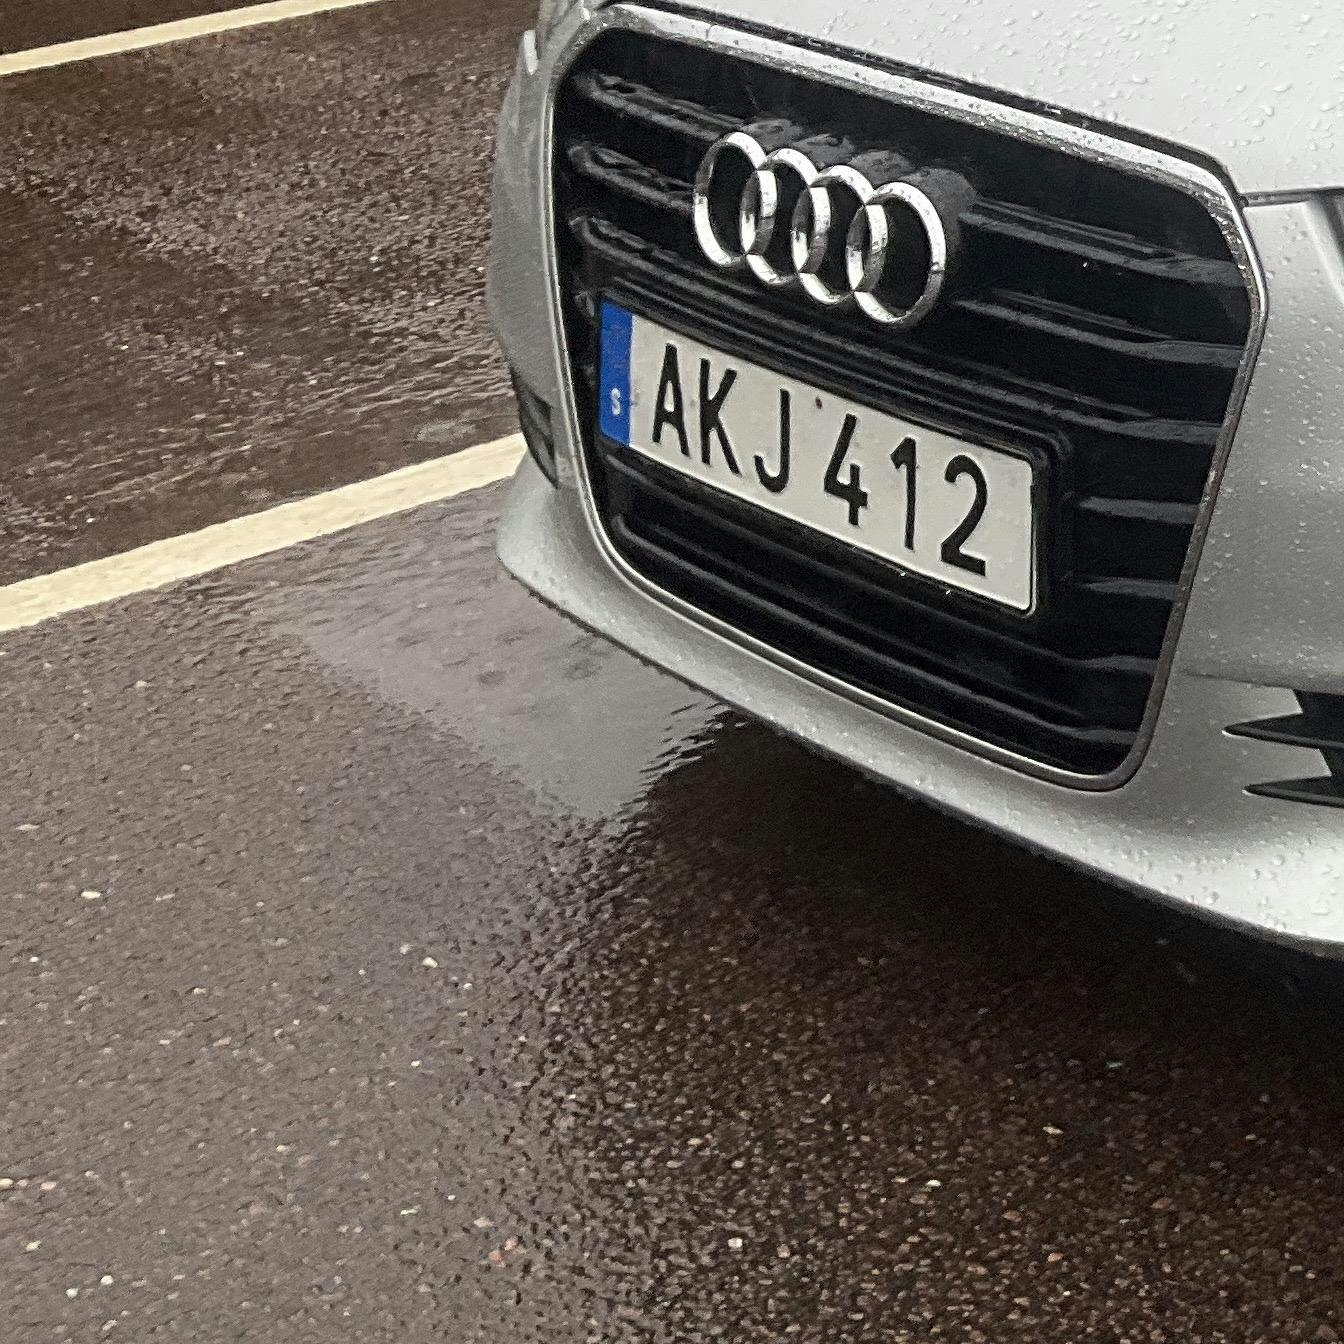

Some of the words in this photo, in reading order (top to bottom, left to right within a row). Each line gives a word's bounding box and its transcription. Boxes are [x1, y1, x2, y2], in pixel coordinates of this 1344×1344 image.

[611, 387, 621, 416] S
[651, 342, 791, 494] AKJ
[823, 412, 989, 577] 412
